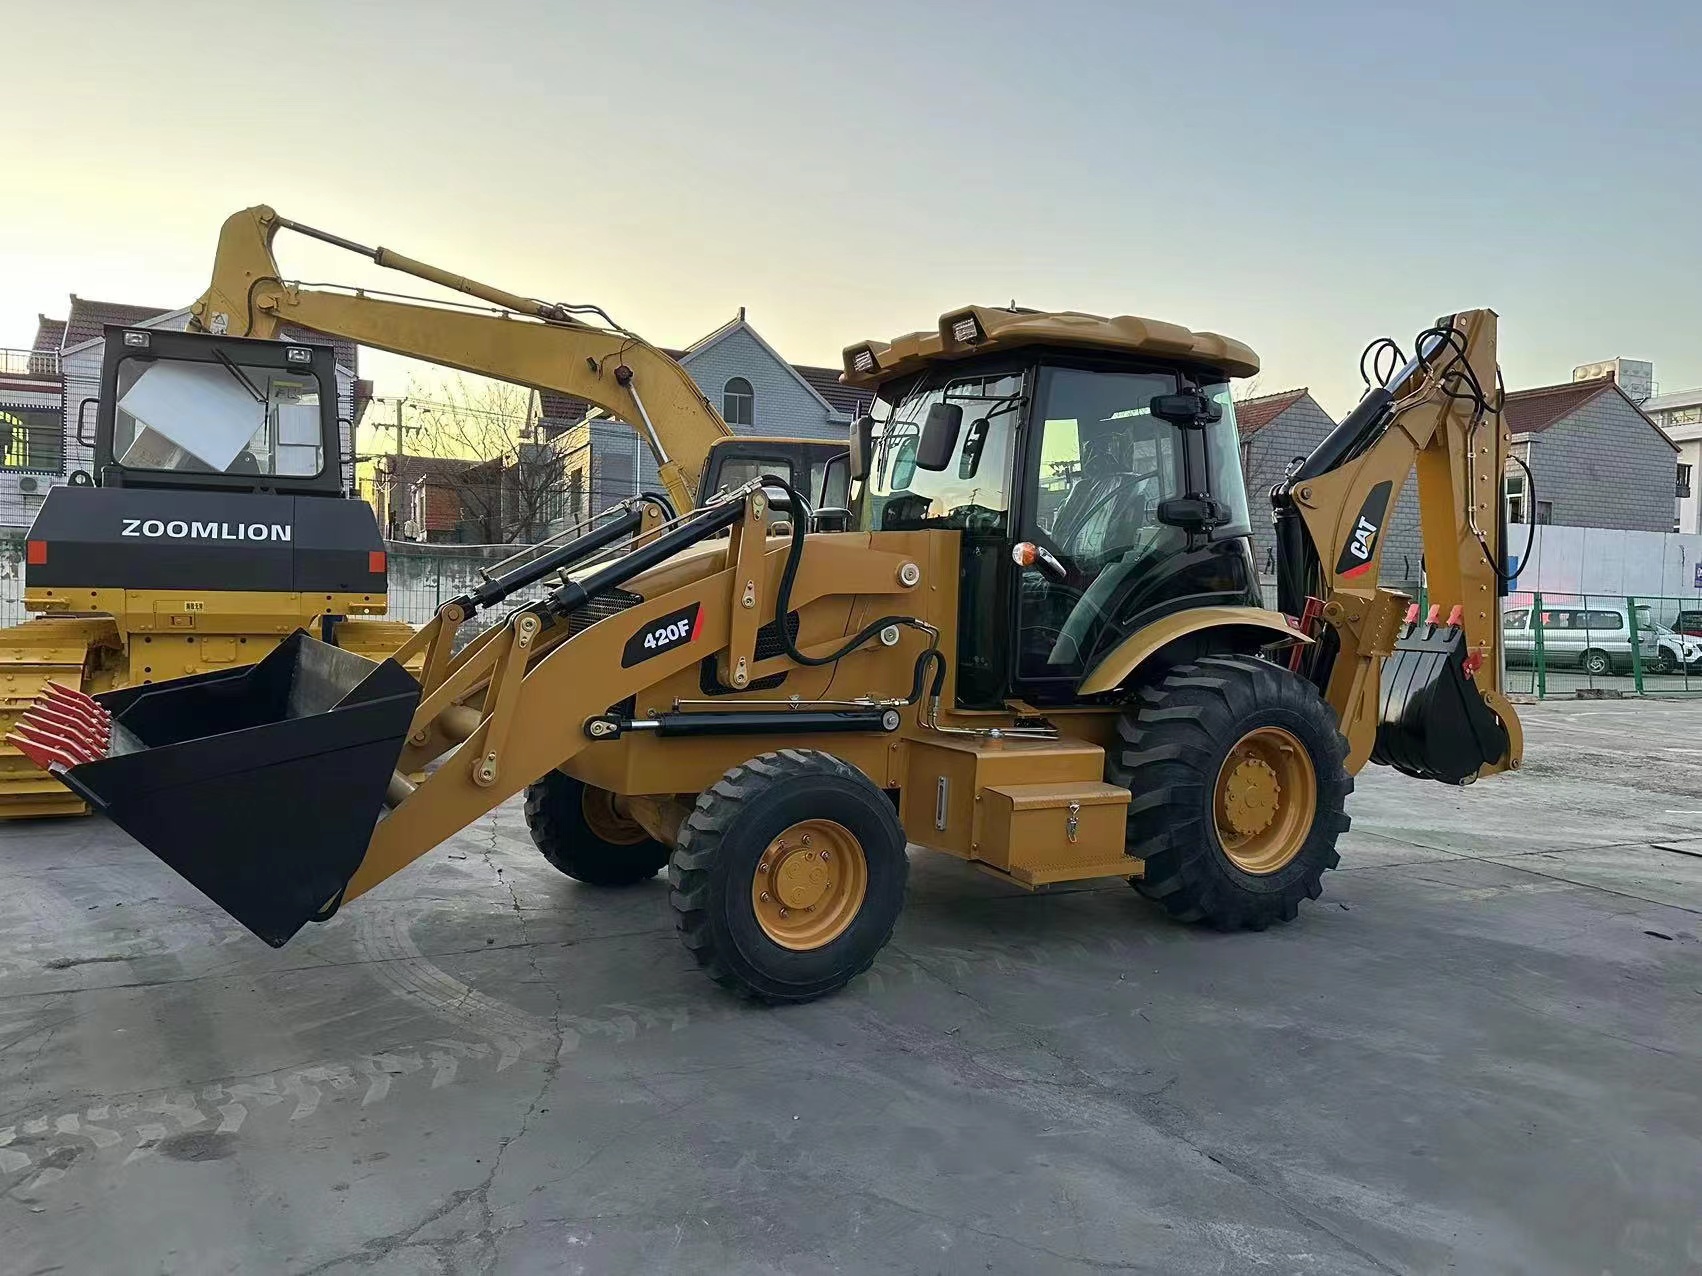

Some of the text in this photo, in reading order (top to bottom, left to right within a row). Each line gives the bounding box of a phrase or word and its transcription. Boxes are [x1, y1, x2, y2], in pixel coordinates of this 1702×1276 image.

[122, 519, 291, 541] ZOOMLION
[1351, 515, 1377, 559] CAT
[644, 619, 689, 648] 420F
